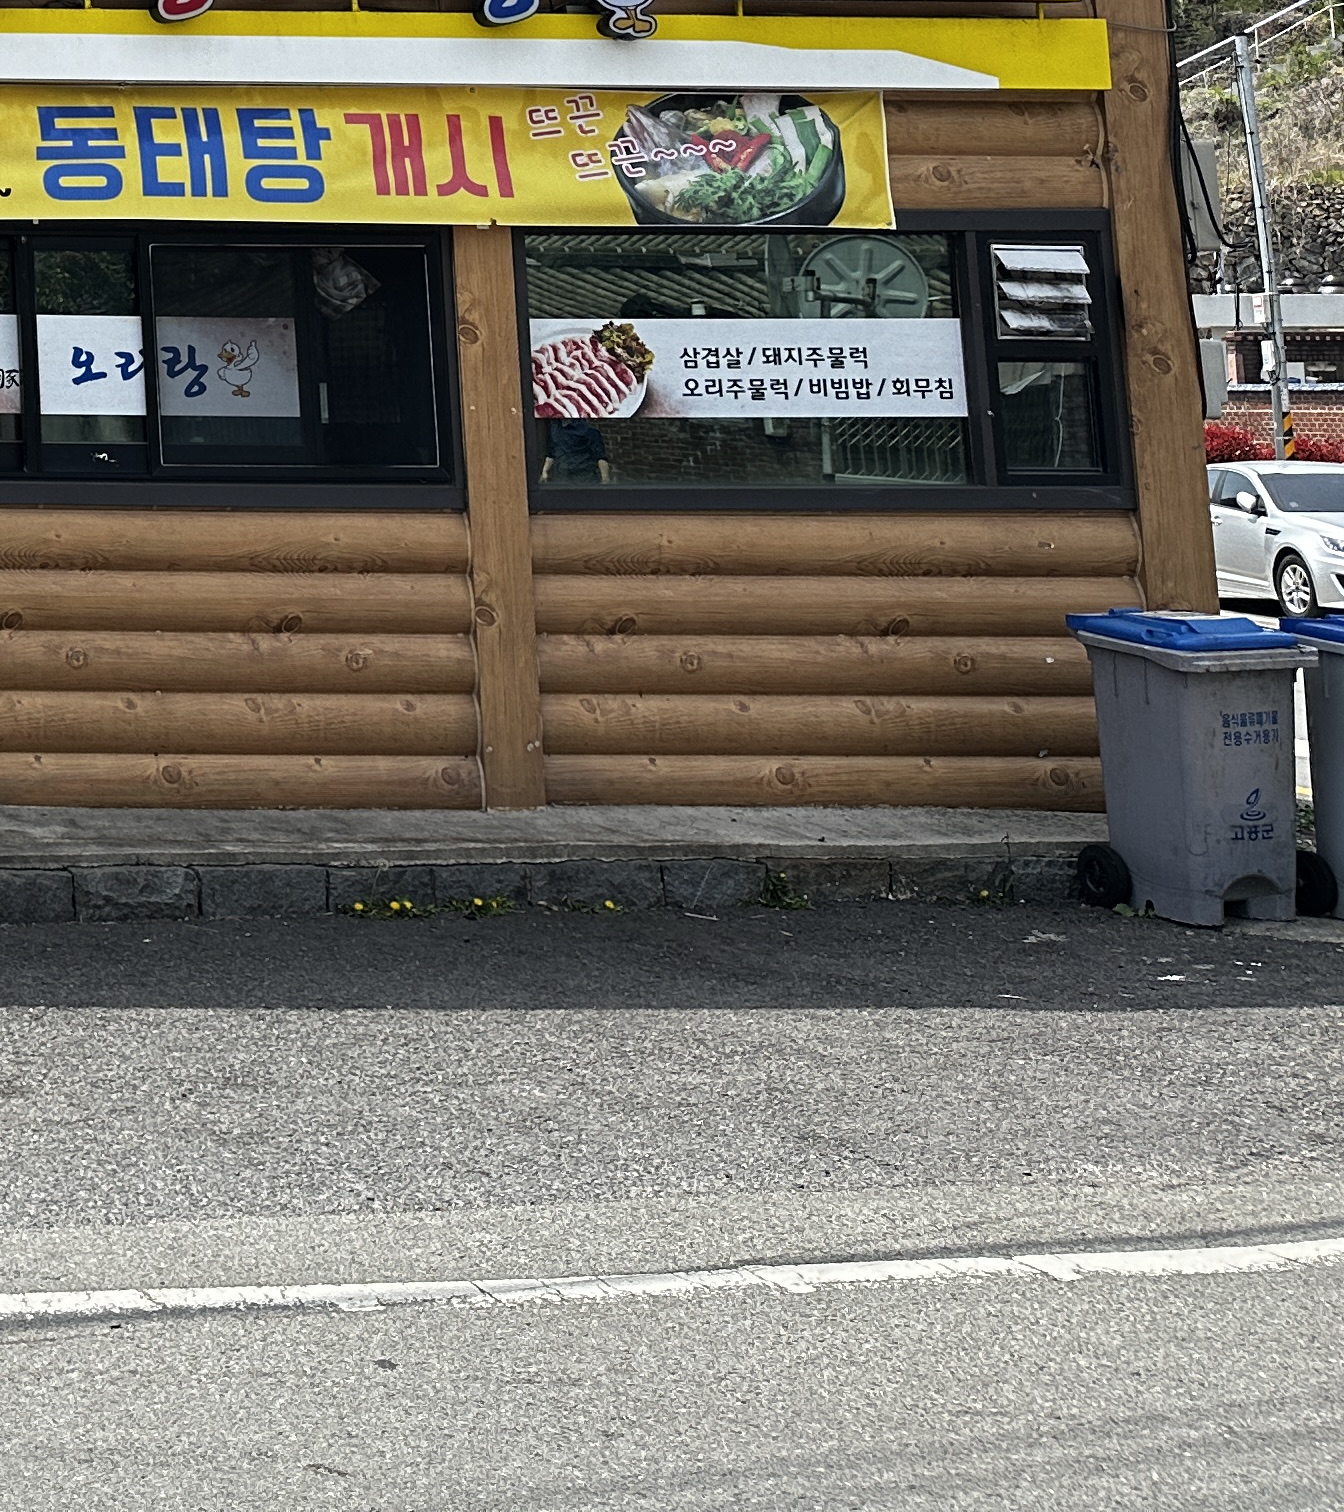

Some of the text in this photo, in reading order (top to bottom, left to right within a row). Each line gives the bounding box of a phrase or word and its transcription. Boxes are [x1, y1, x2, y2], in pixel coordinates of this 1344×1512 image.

[35, 105, 515, 204] 동태탕 개시
[679, 346, 742, 369] 삼겹살
[761, 346, 869, 370] 돼지주물럭
[682, 377, 791, 401] 오리주물럭
[809, 377, 873, 401] 비빔밥
[891, 377, 955, 401] 회무침
[1231, 824, 1274, 841] 고흥군
